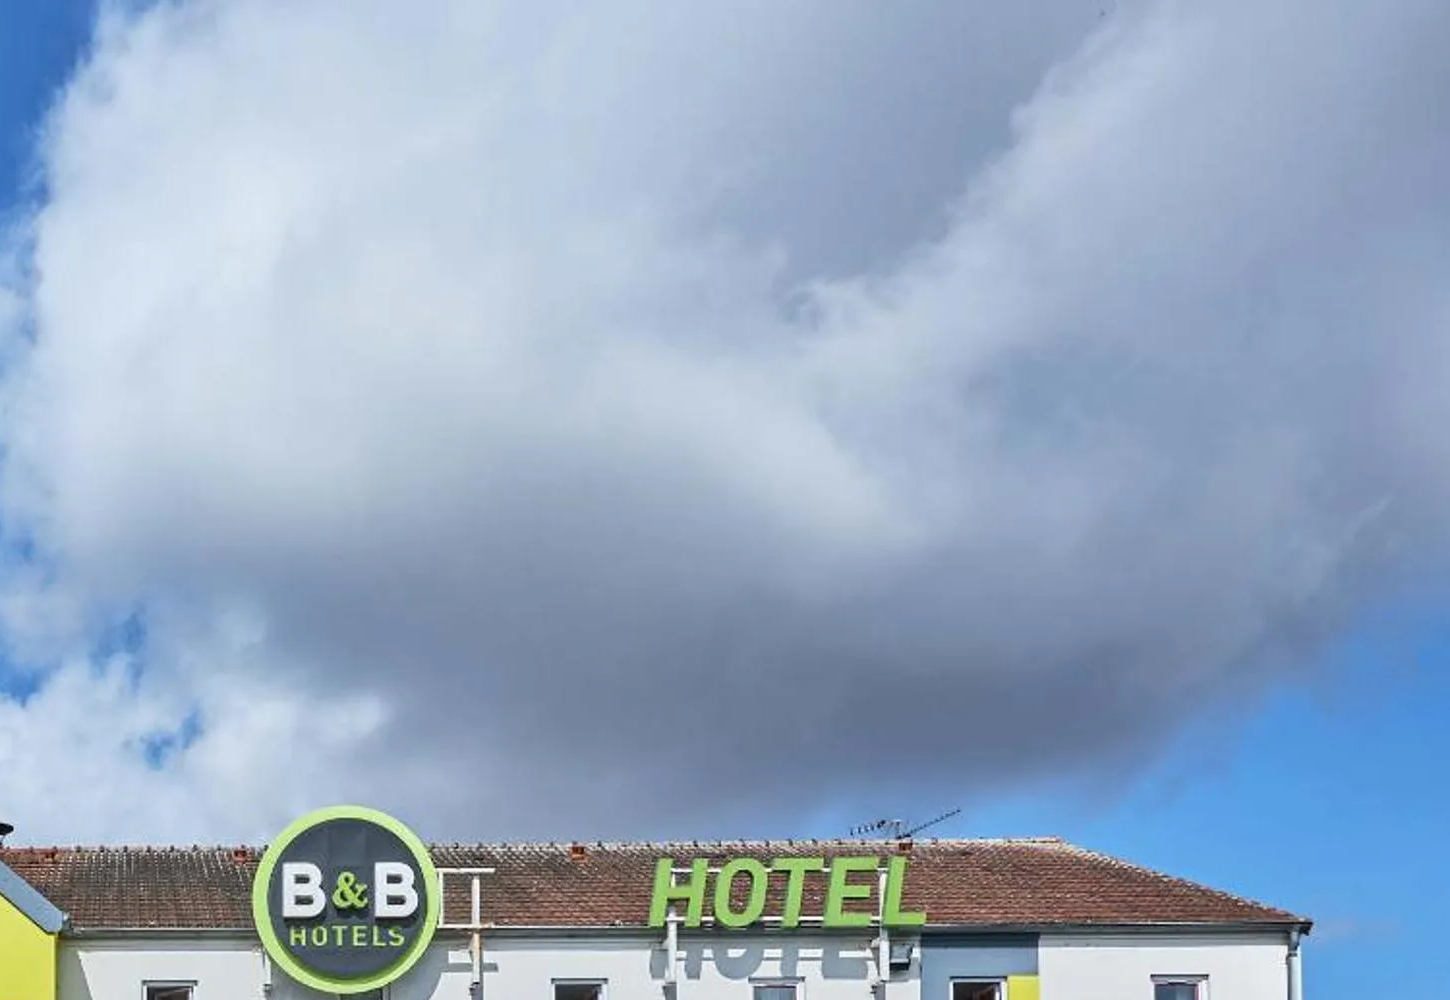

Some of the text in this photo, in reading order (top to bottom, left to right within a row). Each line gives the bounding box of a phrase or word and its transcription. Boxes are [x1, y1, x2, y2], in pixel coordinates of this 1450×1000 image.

[281, 861, 419, 918] B&B
[648, 856, 927, 928] HOTEL
[289, 925, 405, 946] HOTELS
